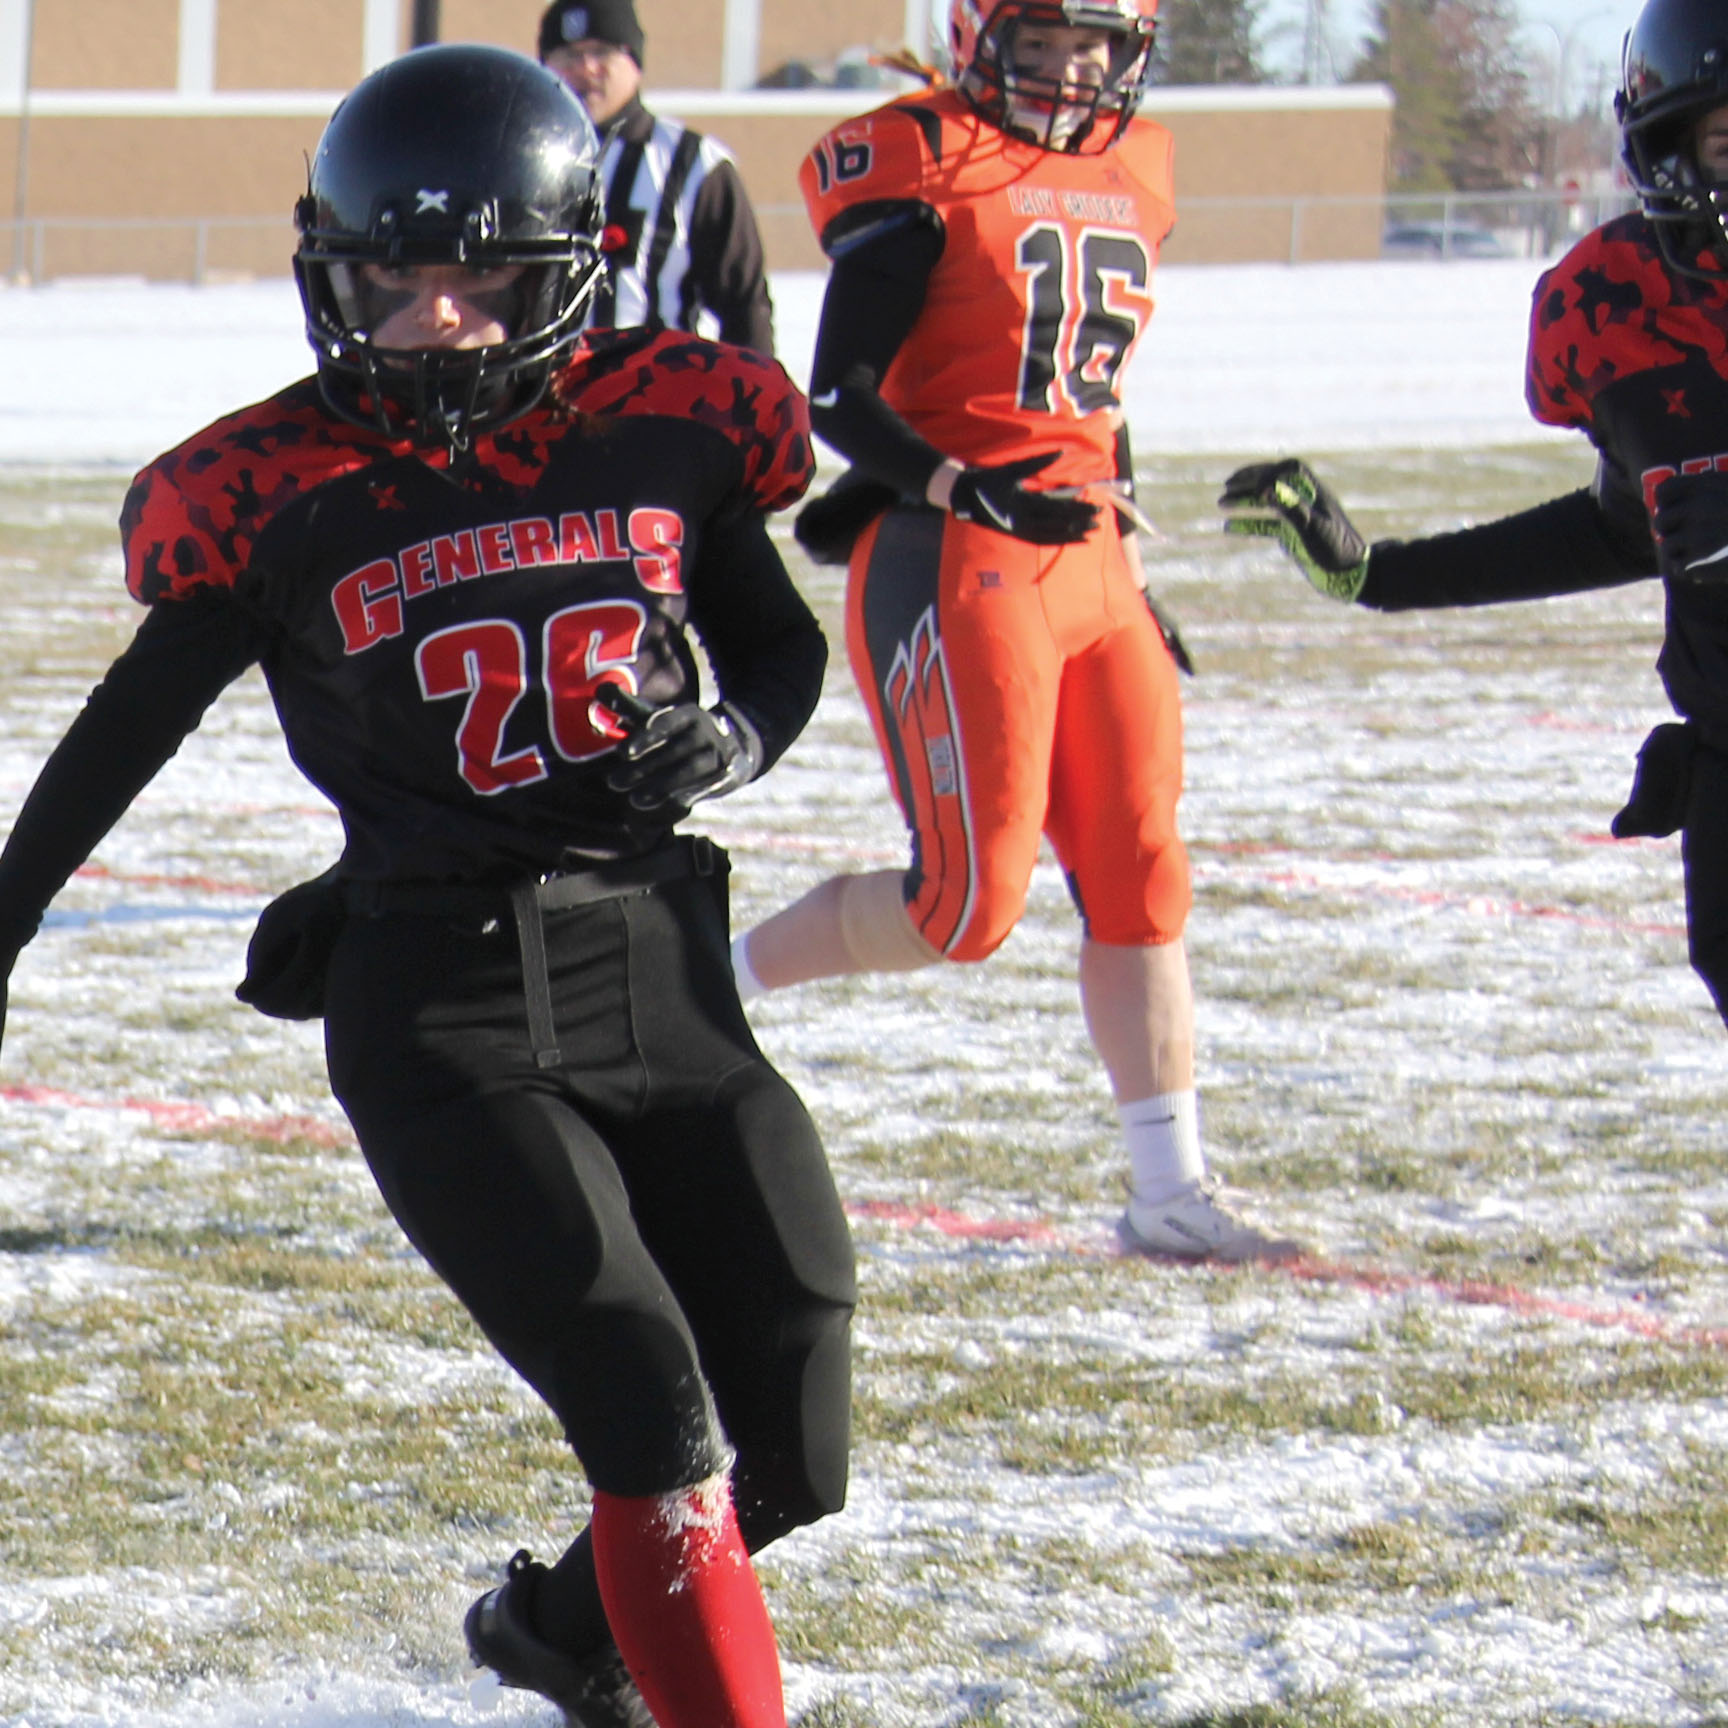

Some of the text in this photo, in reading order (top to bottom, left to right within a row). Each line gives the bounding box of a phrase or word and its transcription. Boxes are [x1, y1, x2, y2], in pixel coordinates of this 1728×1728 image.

[812, 122, 872, 194] 16
[1014, 219, 1150, 418] 16
[331, 508, 685, 655] GENERALS
[413, 598, 646, 796] 26
